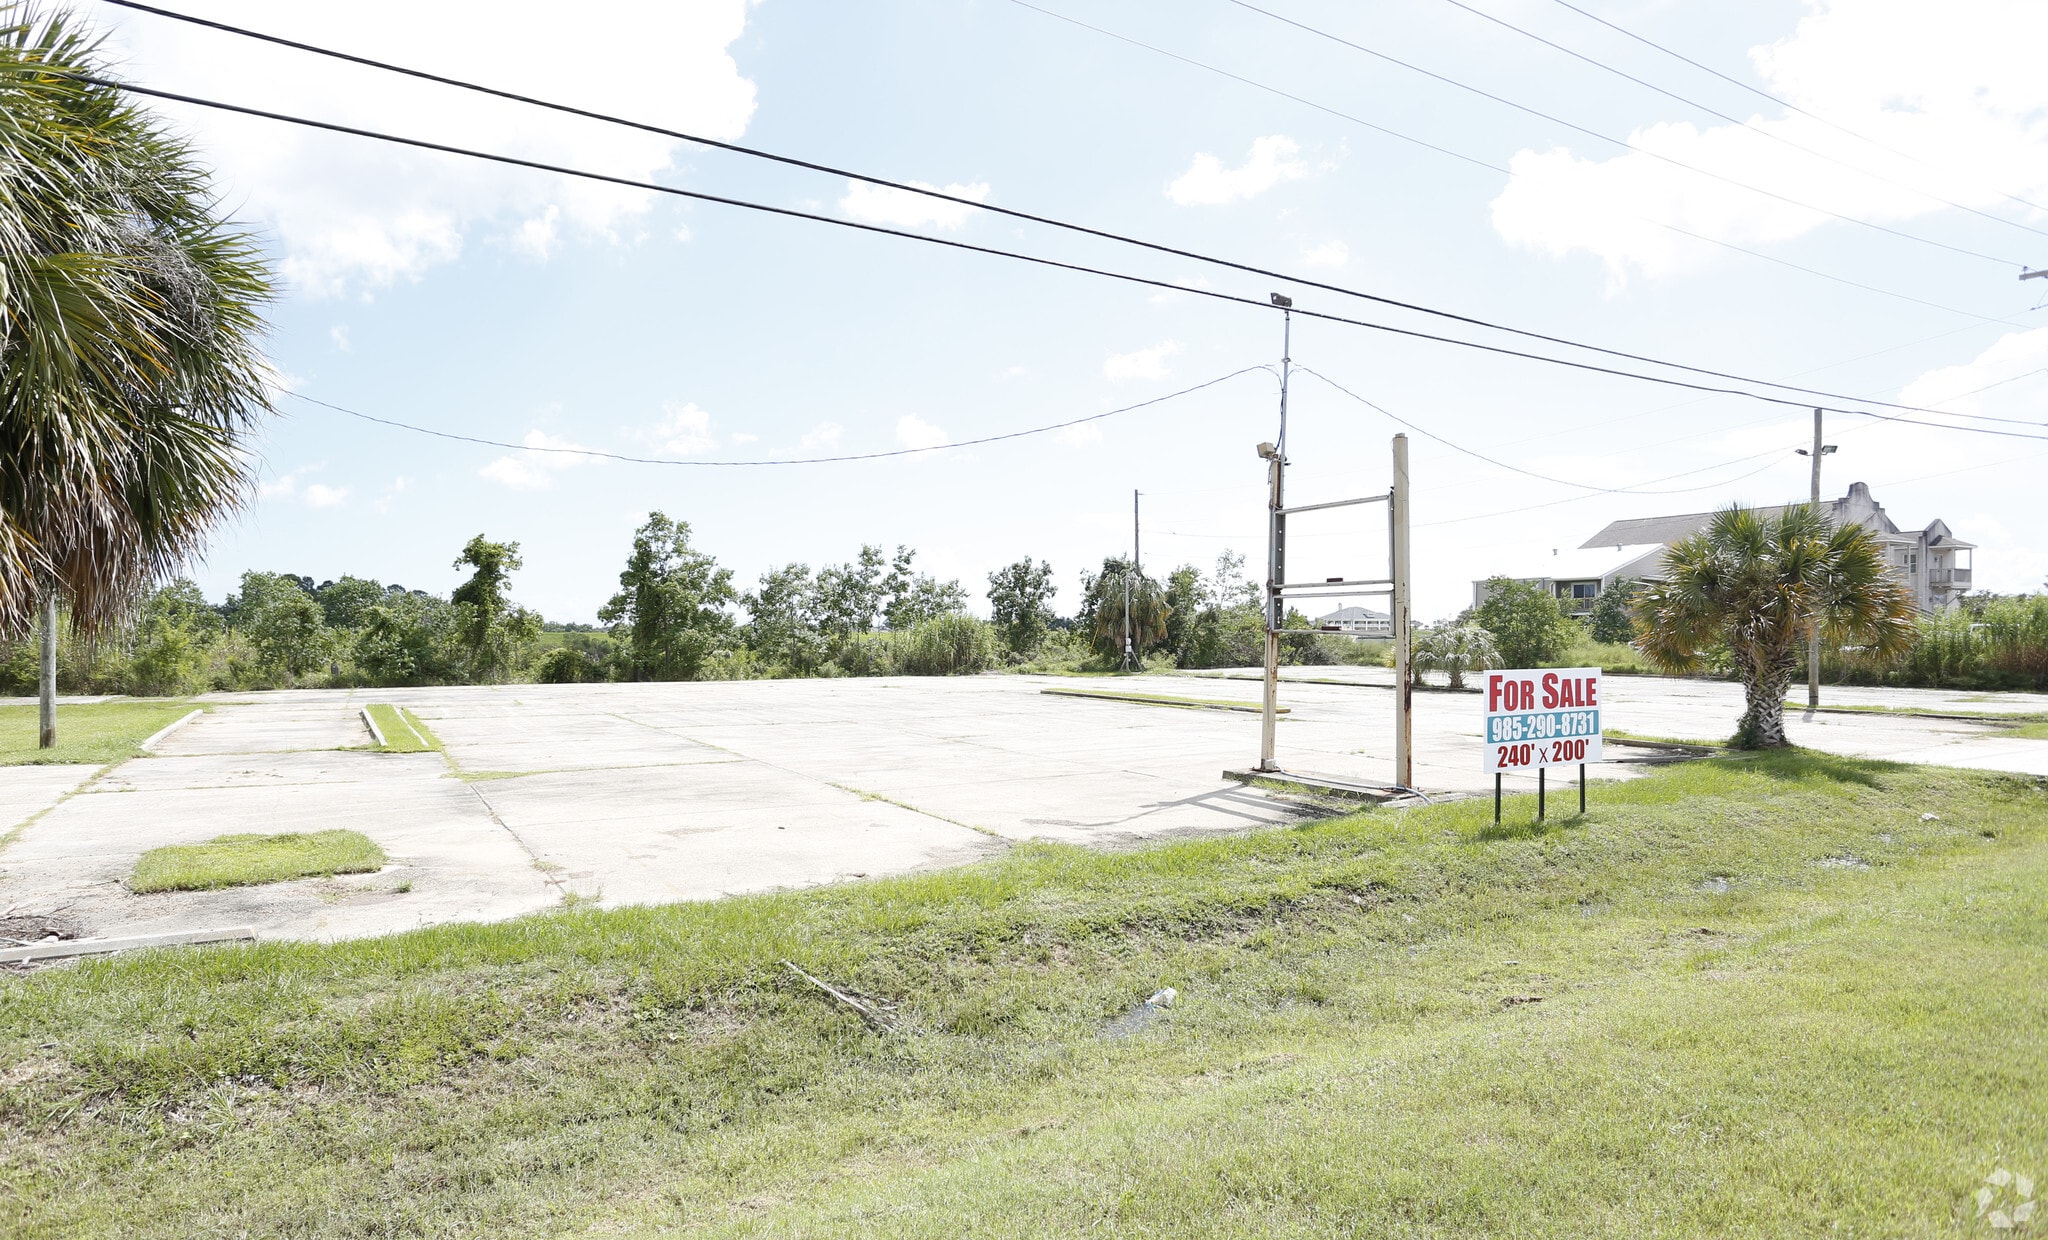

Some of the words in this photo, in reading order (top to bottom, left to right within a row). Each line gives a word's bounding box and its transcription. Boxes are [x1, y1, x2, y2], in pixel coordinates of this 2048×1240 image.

[1489, 675, 1535, 712] FOR
[1541, 672, 1597, 709] SALE
[1492, 712, 1595, 741] 985-290-8731
[1497, 743, 1535, 768] 240'
[1552, 739, 1589, 762] 200'
